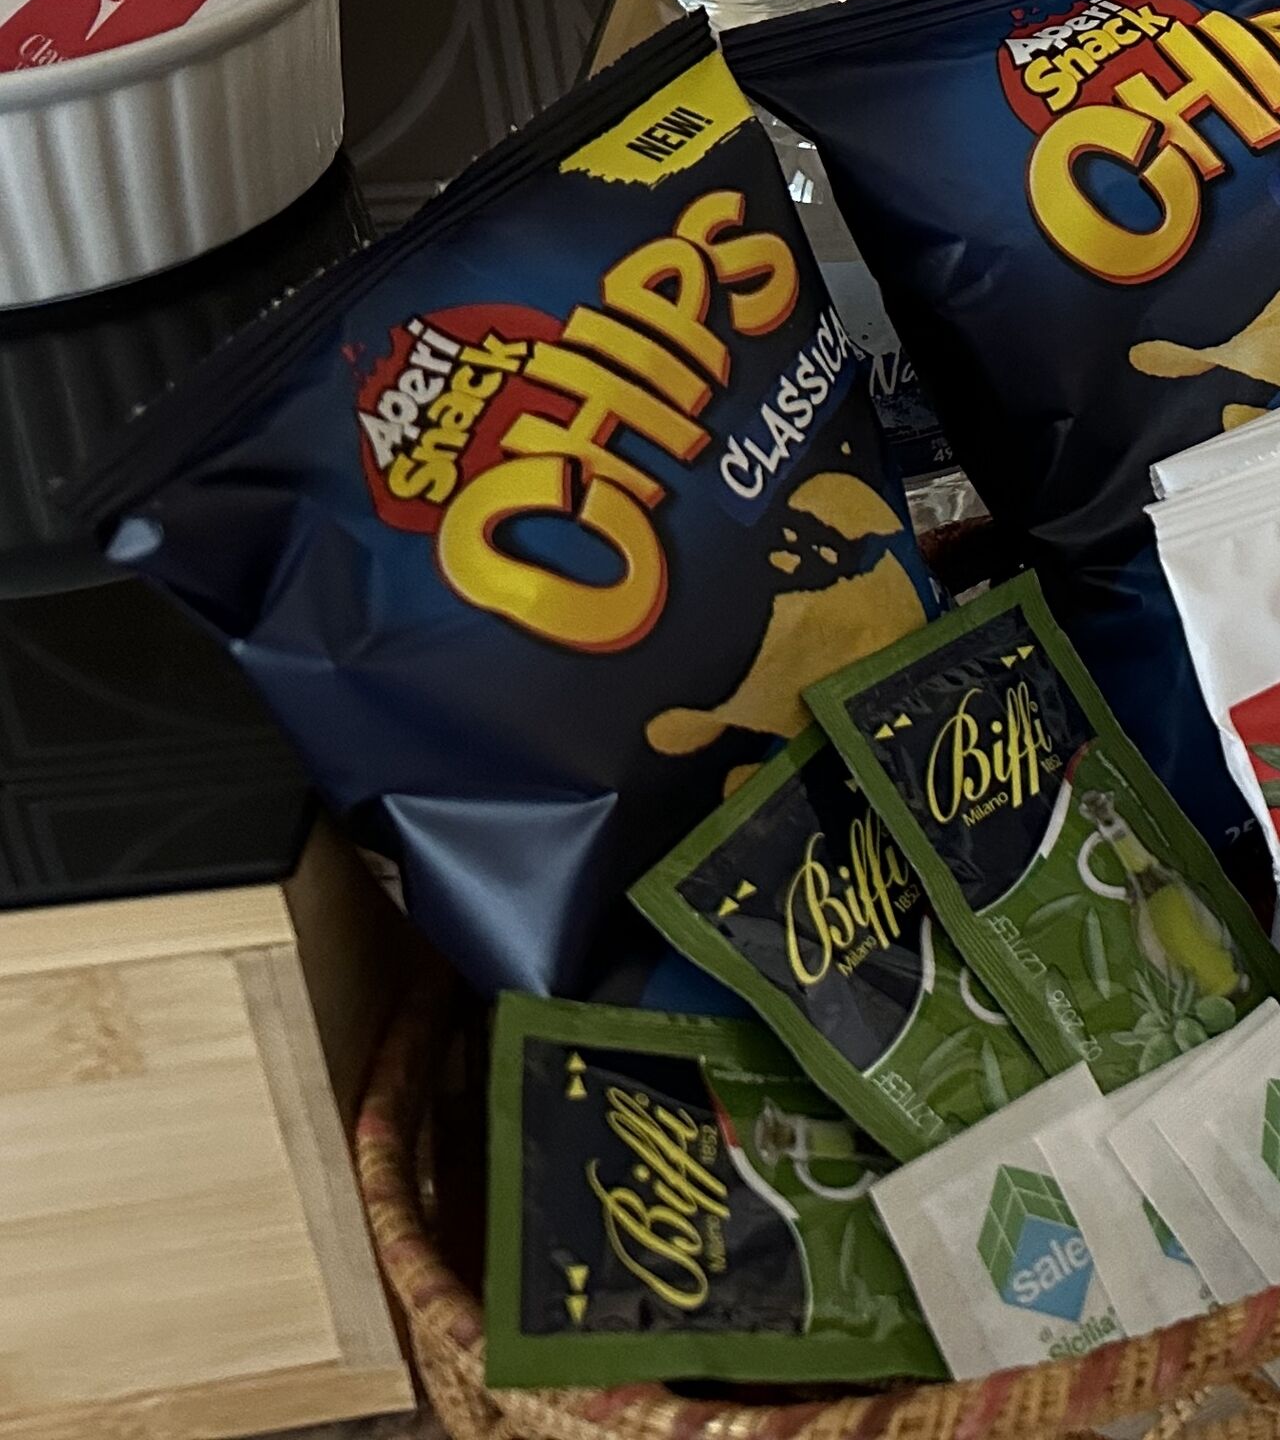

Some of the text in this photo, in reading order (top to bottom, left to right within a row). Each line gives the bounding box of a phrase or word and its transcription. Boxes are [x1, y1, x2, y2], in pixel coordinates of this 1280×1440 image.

[1022, 1, 1172, 113] Snack
[626, 107, 714, 163] NEW!
[358, 318, 463, 468] Aperi
[388, 334, 530, 504] Snack
[436, 190, 798, 653] CHIPS
[927, 681, 1053, 824] Biffi
[962, 790, 1010, 828] Milano
[785, 808, 909, 986] Biffi
[836, 934, 878, 978] Milano
[893, 874, 922, 914] 1852
[588, 1087, 730, 1311] Biffi
[1011, 1236, 1091, 1304] sale
